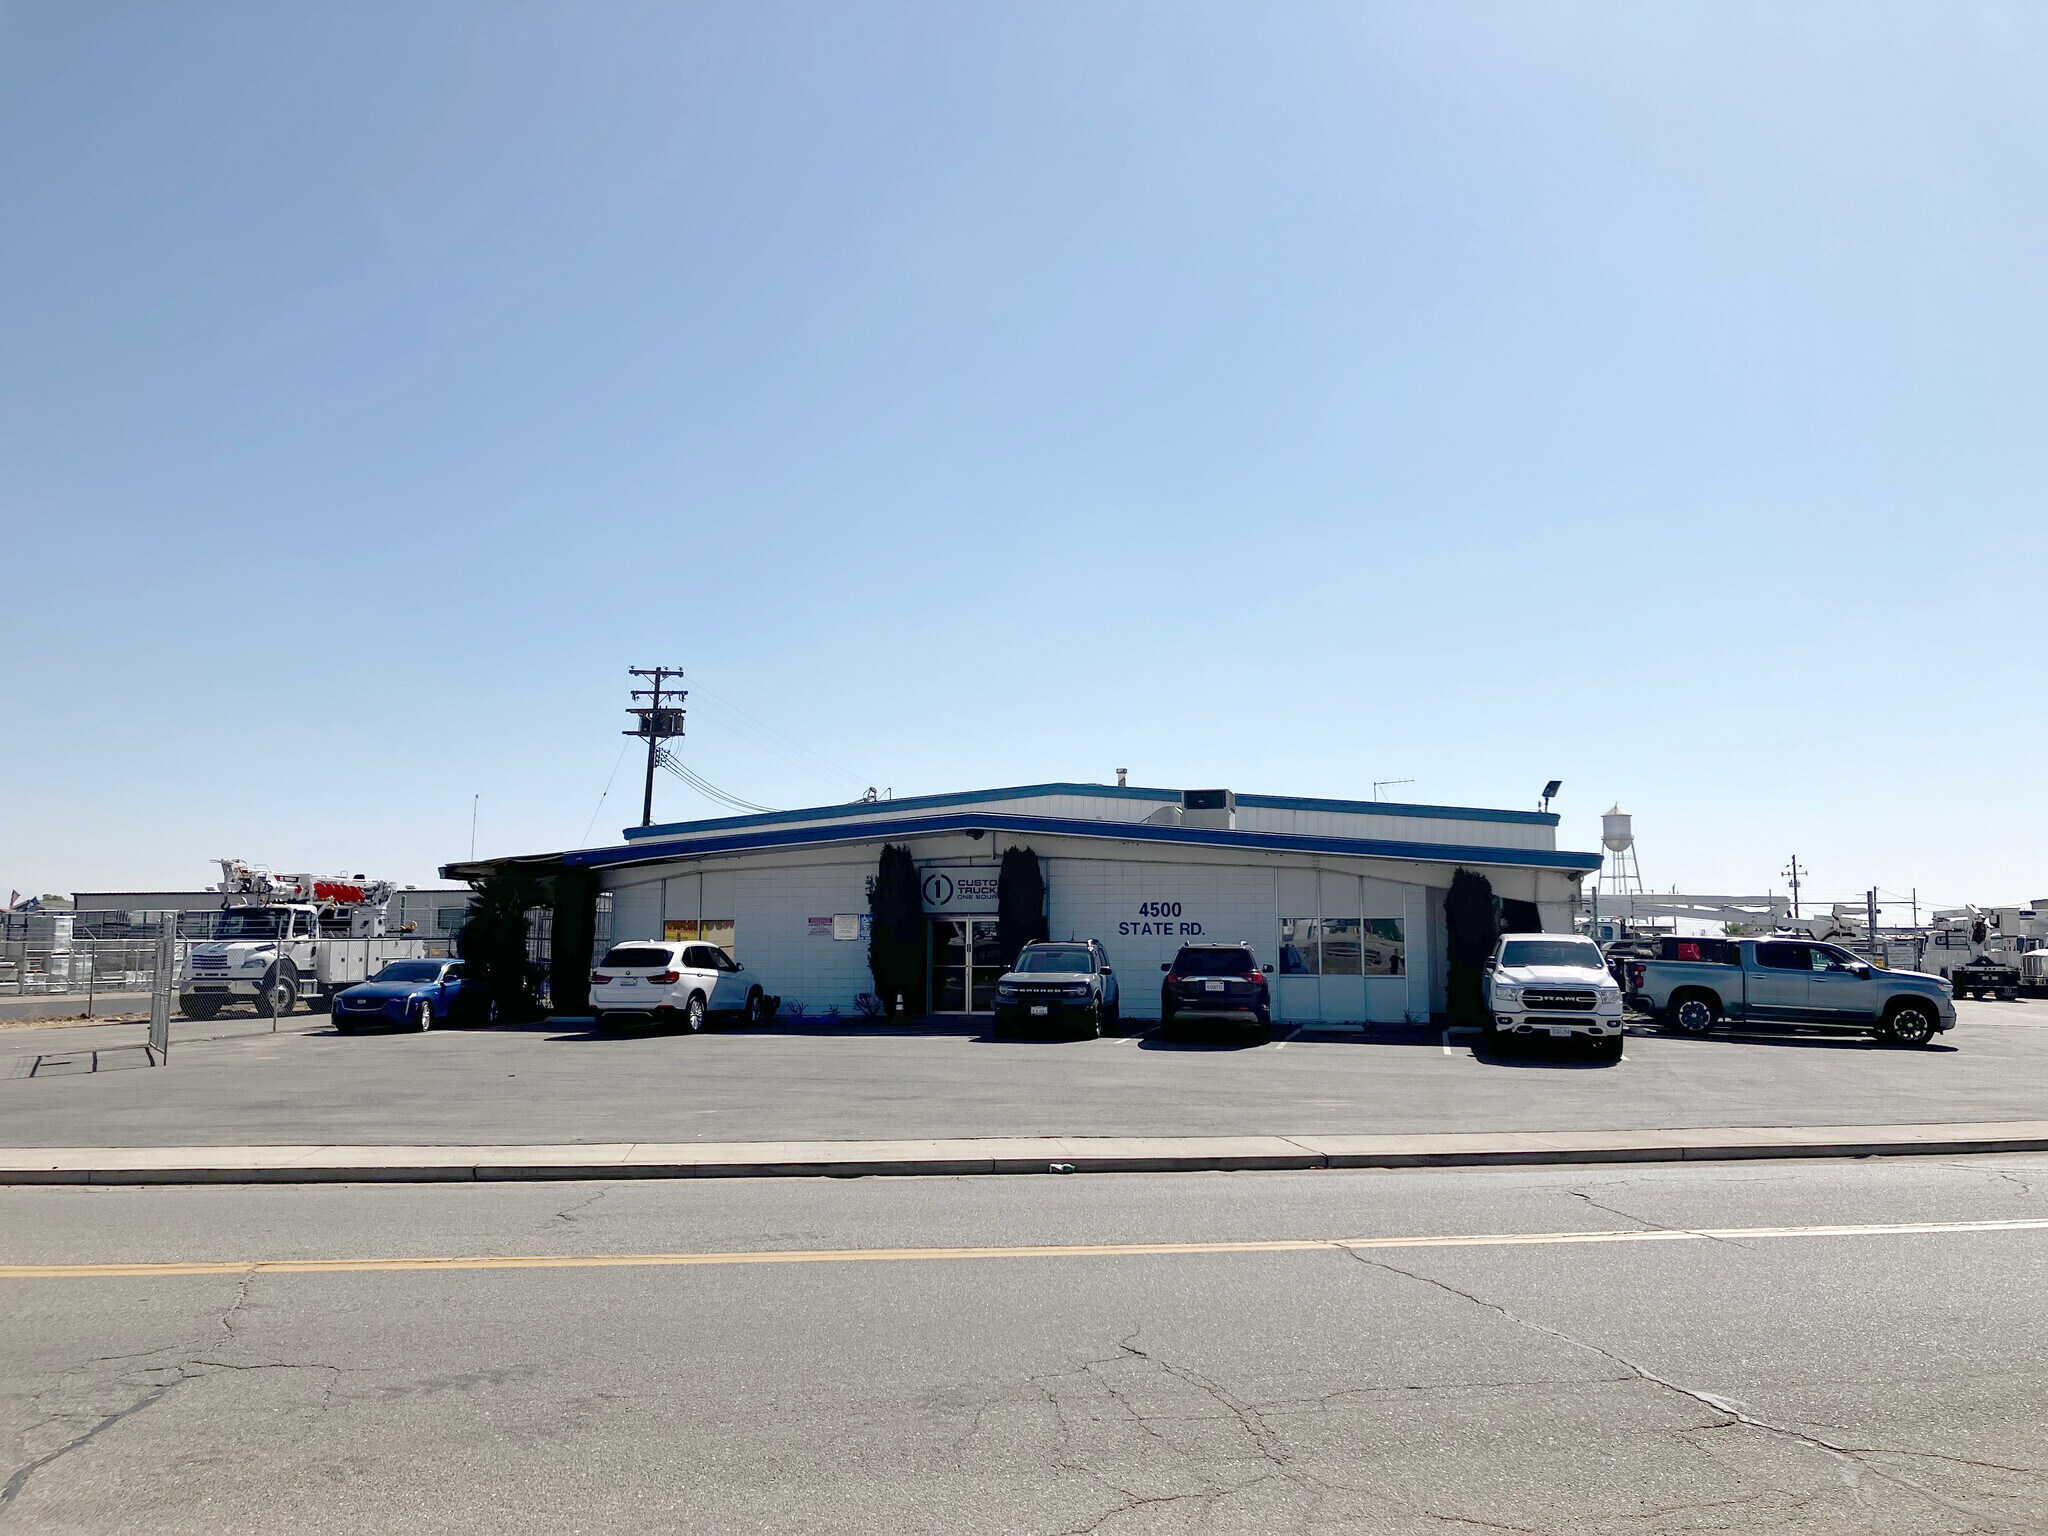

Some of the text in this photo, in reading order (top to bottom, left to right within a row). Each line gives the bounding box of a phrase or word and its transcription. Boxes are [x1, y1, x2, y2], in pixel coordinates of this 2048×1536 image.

[1139, 902, 1182, 917] 4500
[1118, 921, 1206, 936] STATE RD.
